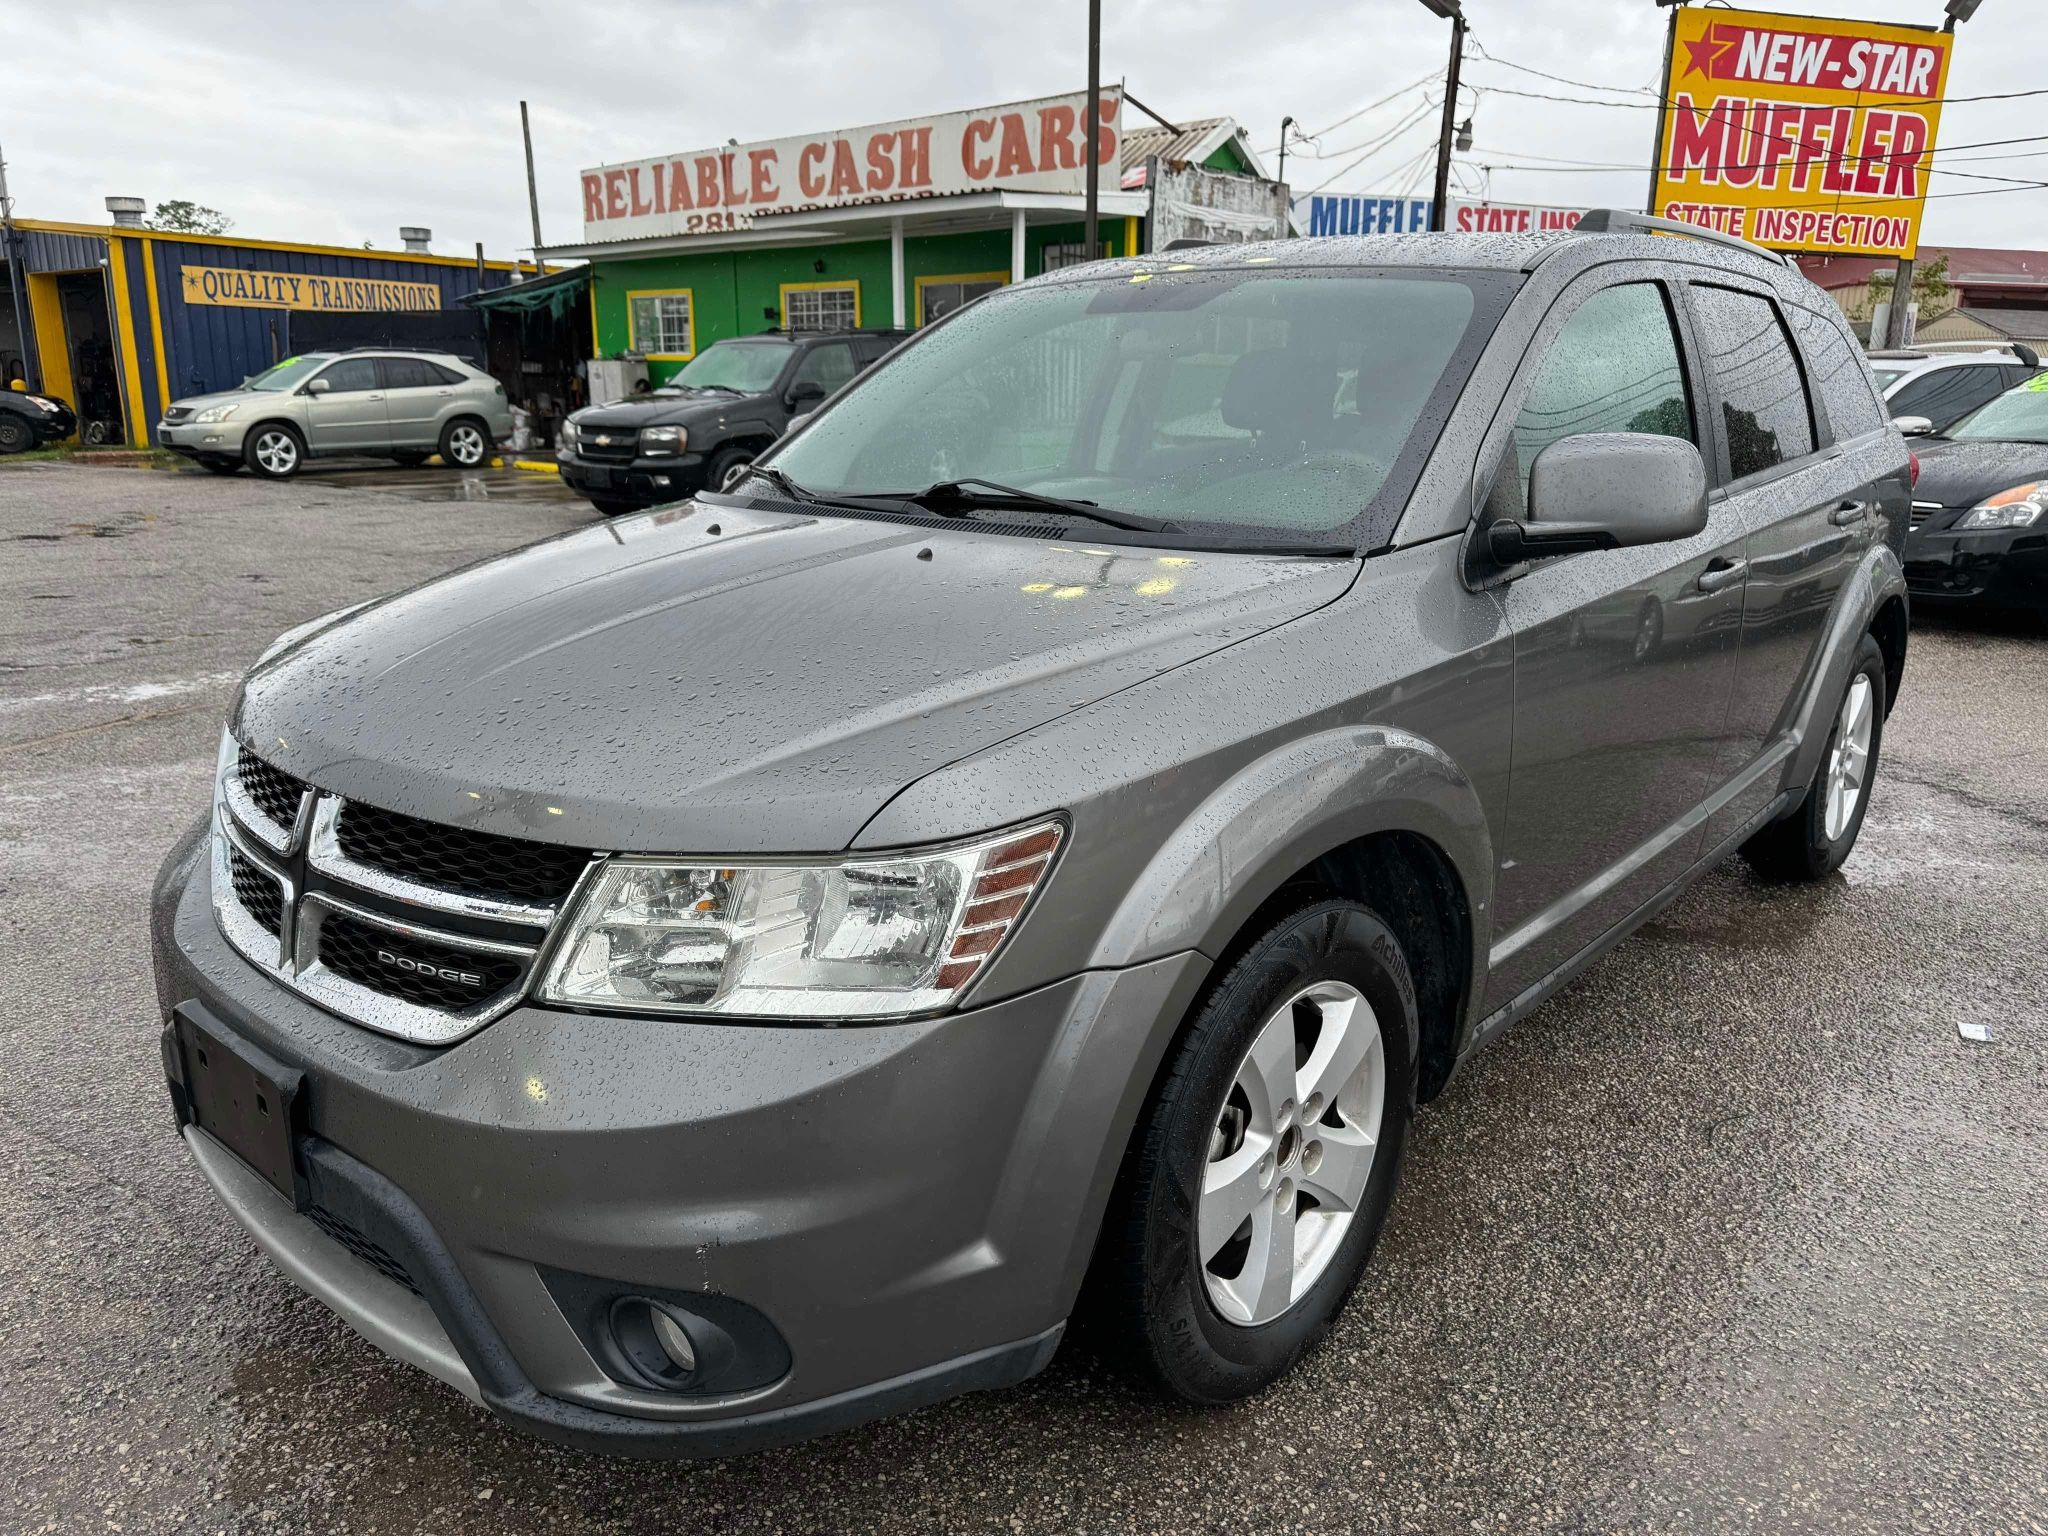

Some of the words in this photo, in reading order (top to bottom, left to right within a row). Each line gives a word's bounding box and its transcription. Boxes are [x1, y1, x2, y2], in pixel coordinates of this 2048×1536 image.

[1735, 31, 1935, 95] NEW-STAR
[584, 148, 781, 223] RELIABLE
[799, 127, 933, 198] CASH
[961, 98, 1120, 192] CARS
[1666, 92, 1928, 199] MUFFLER
[1456, 206, 1531, 233] STATE
[1664, 202, 1745, 237] STATE
[1753, 207, 1910, 250] INSPECTION
[202, 269, 302, 303] QUALITY
[308, 278, 436, 312] TRANSMISSIONS
[377, 950, 481, 986] DODGE
